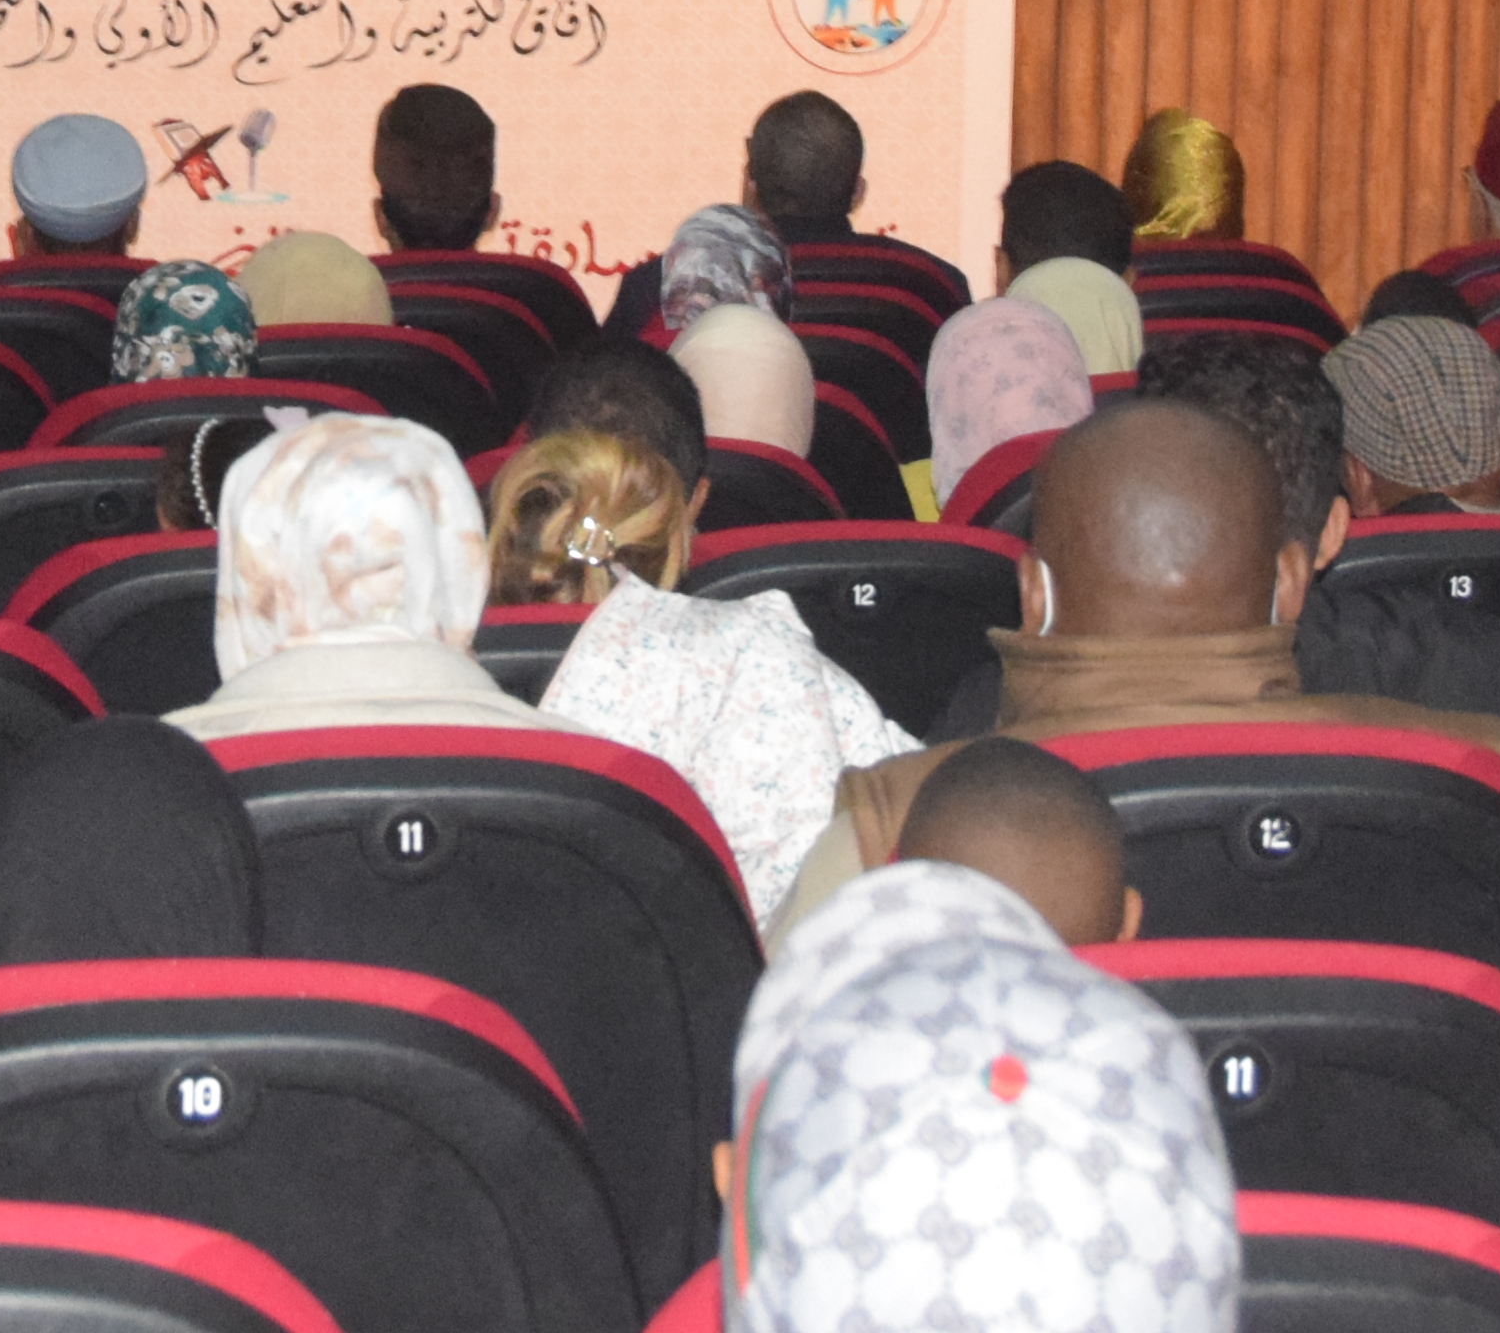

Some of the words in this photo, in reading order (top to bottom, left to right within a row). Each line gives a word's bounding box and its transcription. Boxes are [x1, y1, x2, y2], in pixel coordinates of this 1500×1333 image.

[853, 583, 877, 607] 12
[1450, 575, 1473, 599] 13
[398, 820, 425, 854] 11
[1259, 817, 1292, 853] 12
[1224, 1056, 1257, 1097] 11
[179, 1076, 223, 1120] 10
